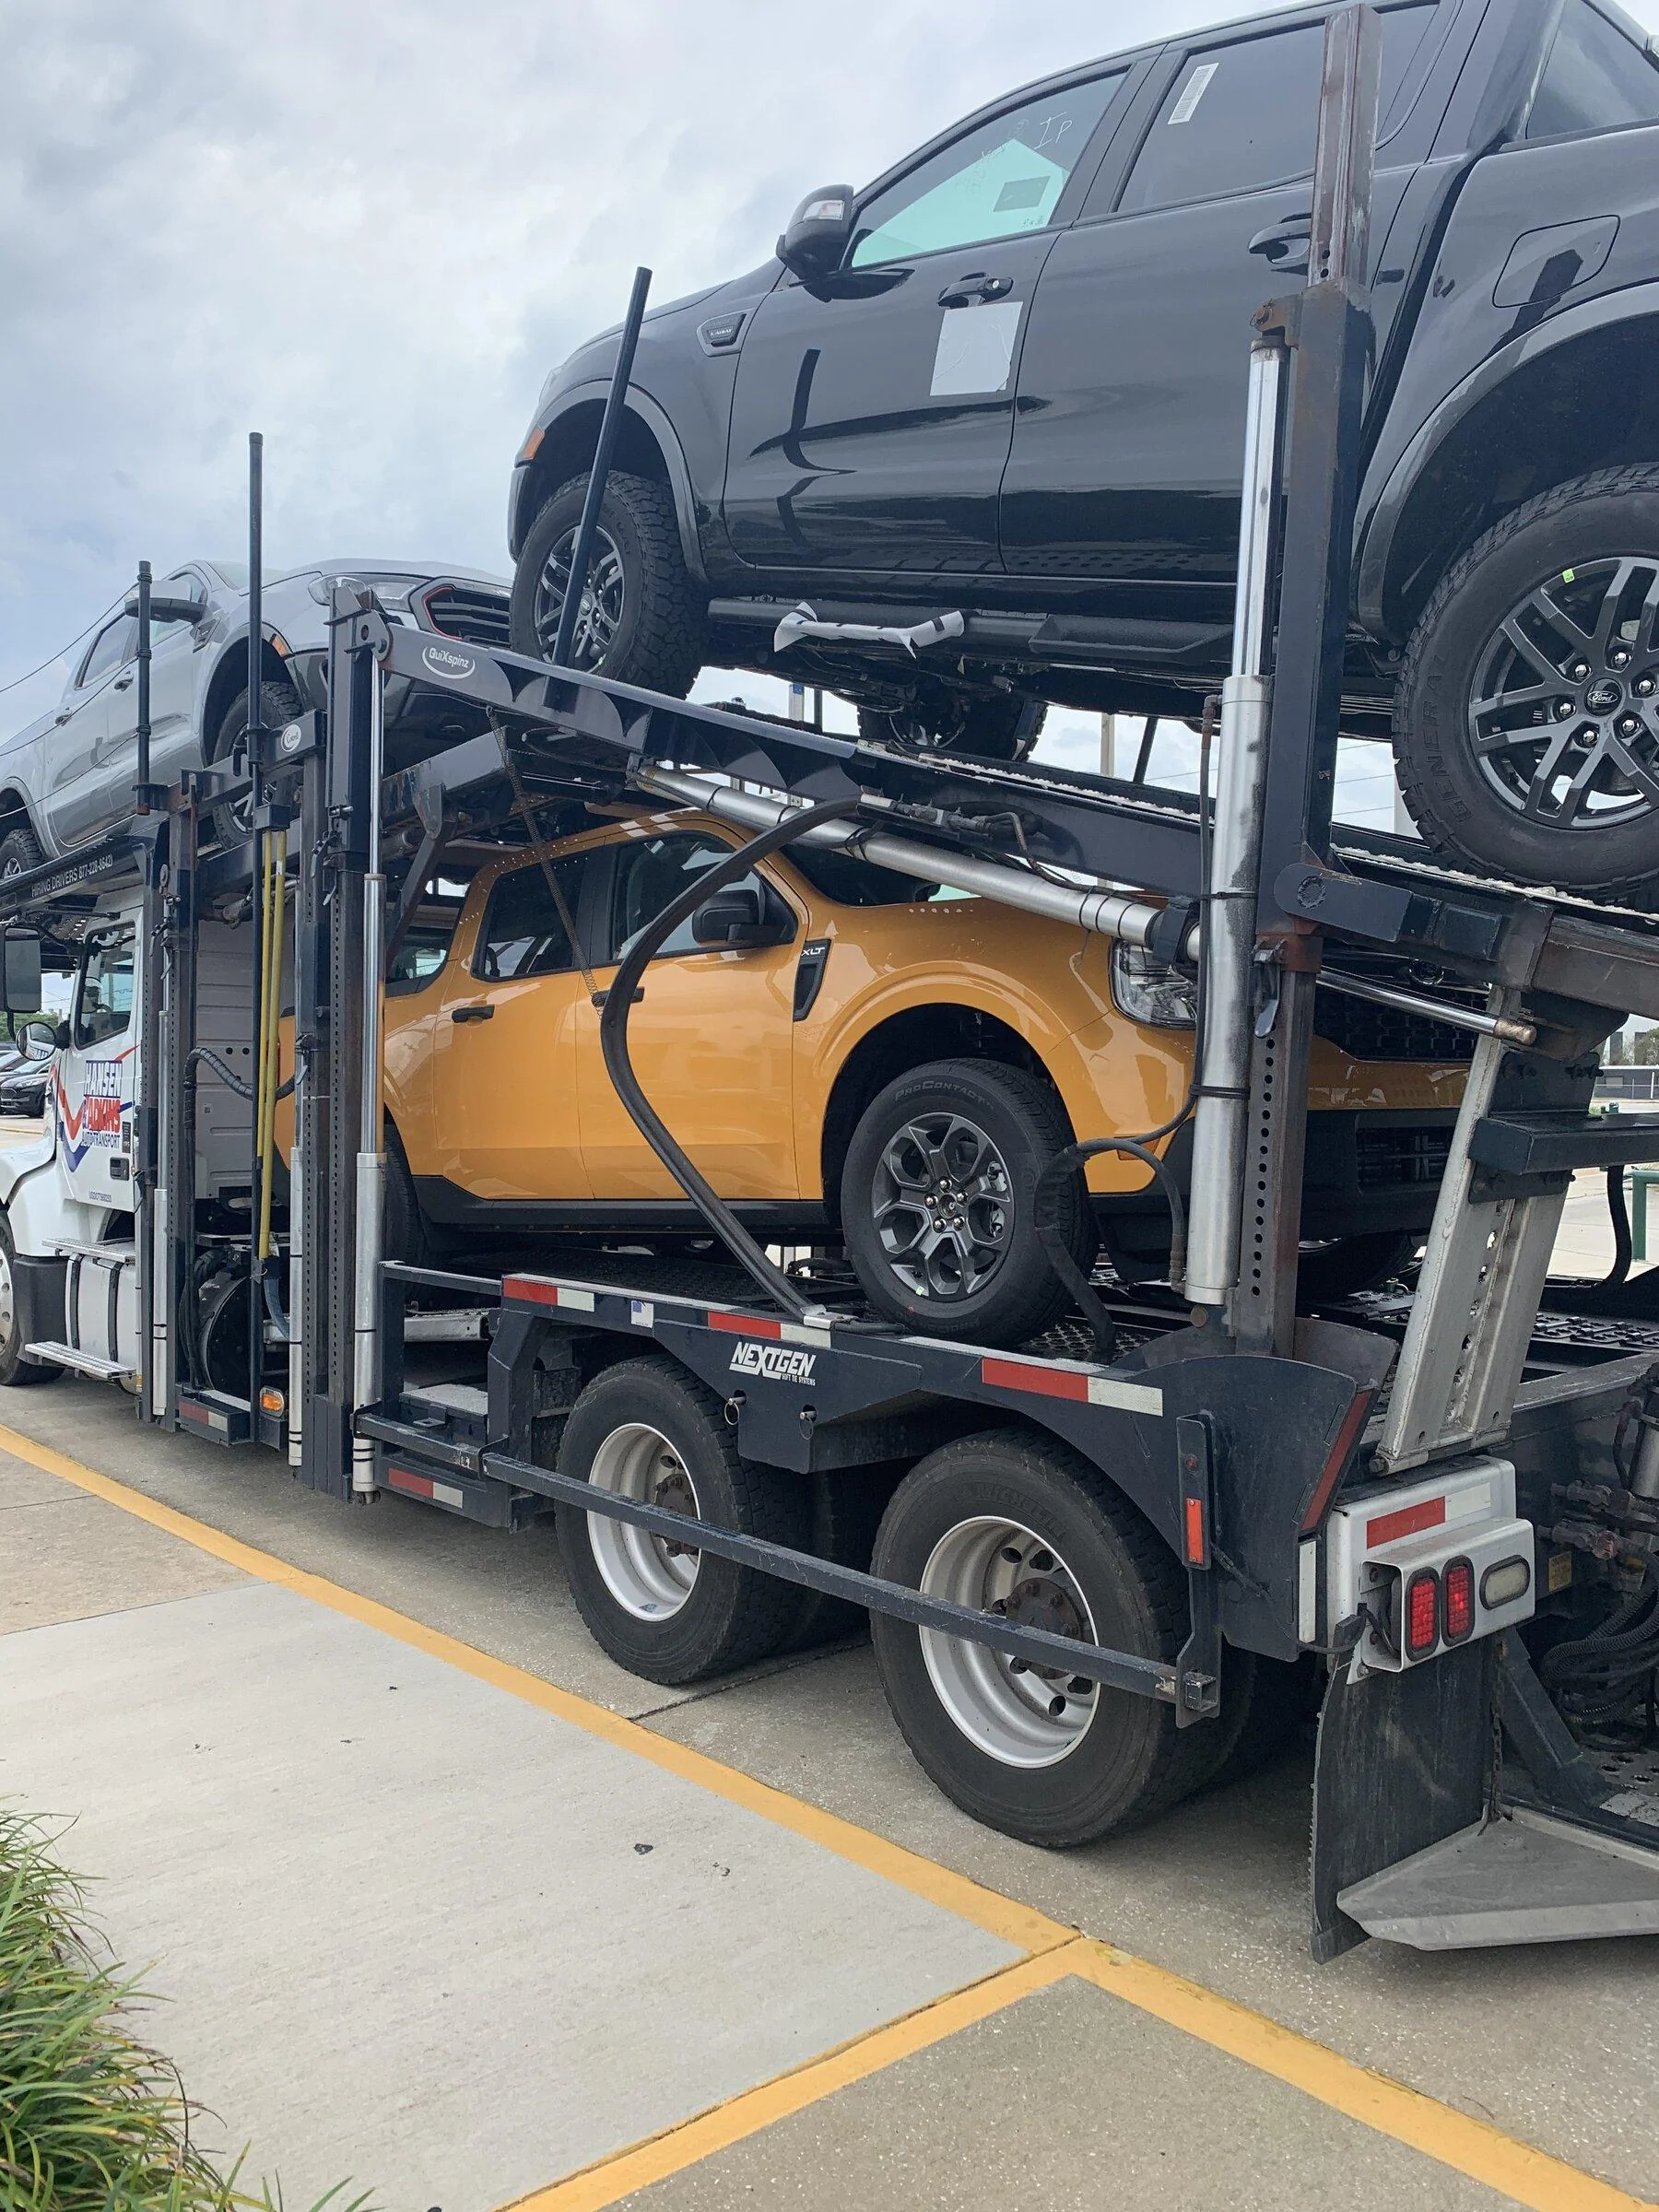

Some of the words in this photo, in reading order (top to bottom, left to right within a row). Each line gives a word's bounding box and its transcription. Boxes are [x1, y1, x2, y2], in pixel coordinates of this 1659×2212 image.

[52, 868, 77, 889] DRIVERS
[801, 947, 826, 957] XLT
[84, 1062, 123, 1097] HANSEN
[729, 1341, 817, 1381] NEXTGEN
